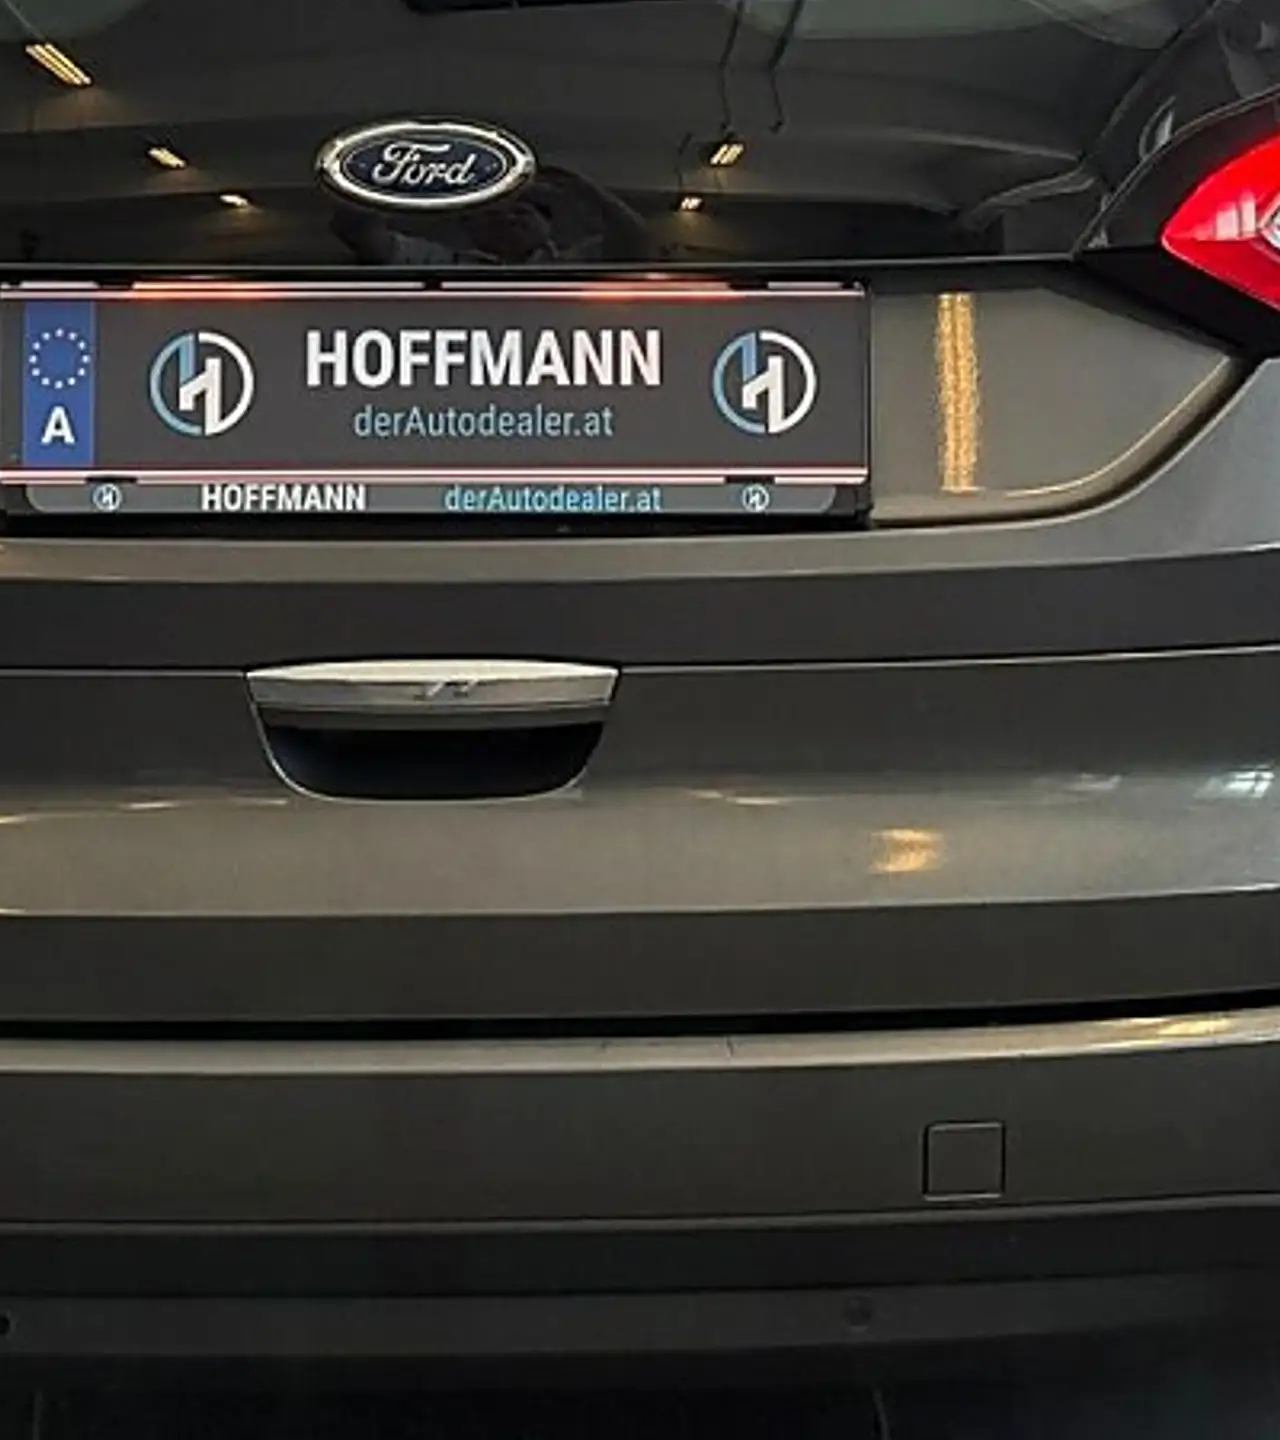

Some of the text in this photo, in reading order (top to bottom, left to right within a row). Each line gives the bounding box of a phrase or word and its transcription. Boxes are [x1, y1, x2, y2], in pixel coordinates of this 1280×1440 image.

[371, 142, 479, 185] Ford
[306, 329, 661, 387] HOFFMANN
[40, 406, 76, 445] A
[354, 404, 614, 438] derAutodealer.at
[200, 483, 662, 513] HOFFMANN derAutodealer.at
